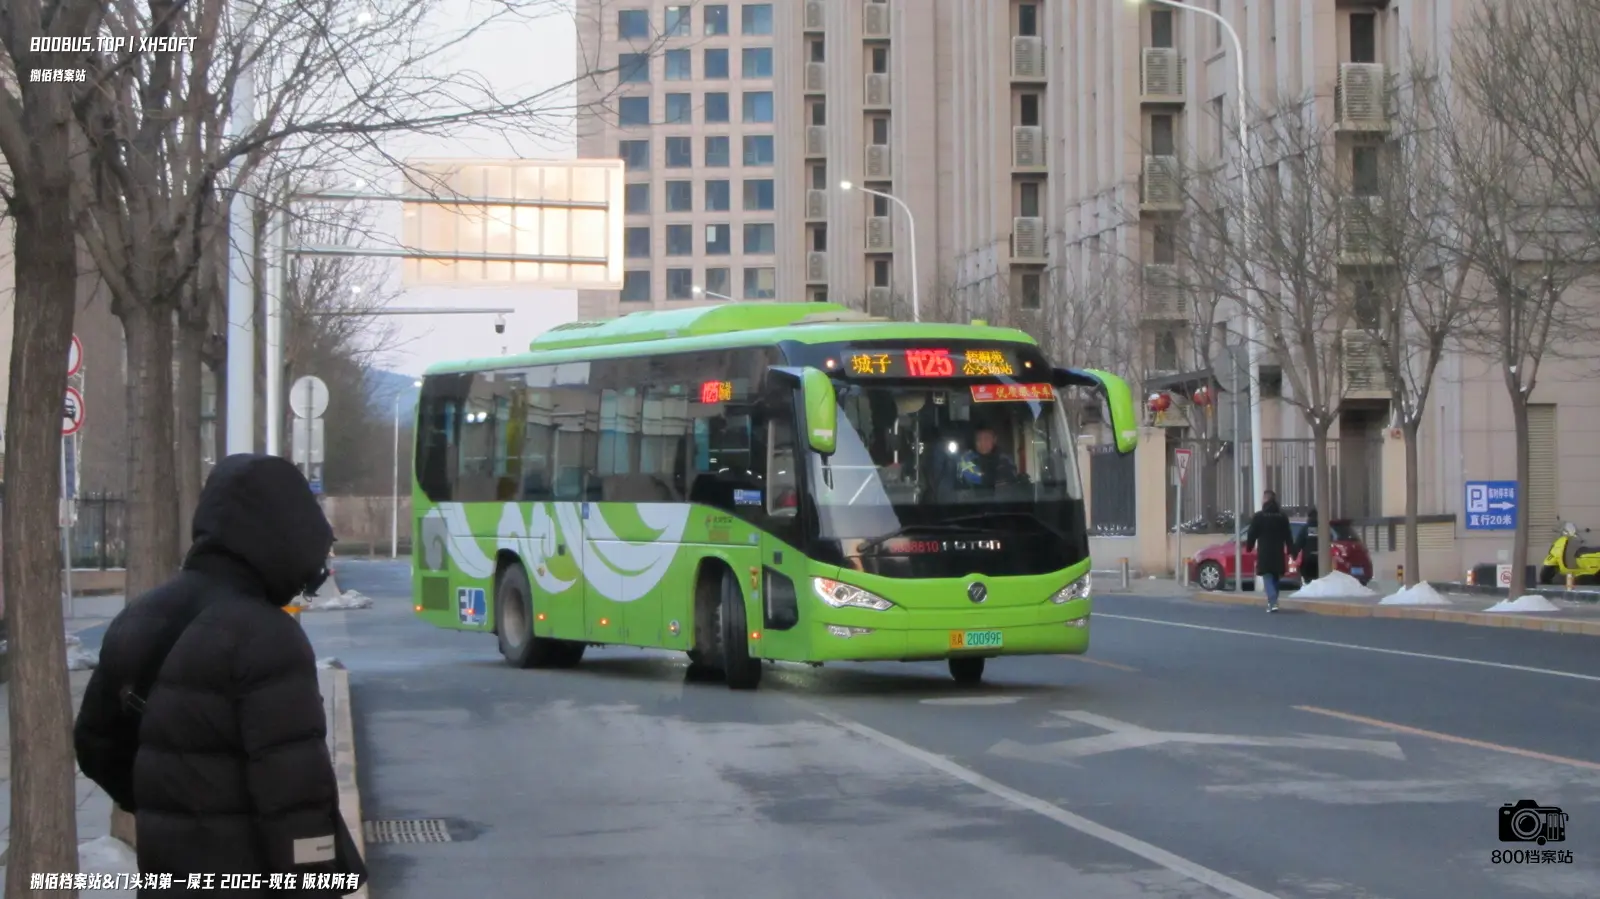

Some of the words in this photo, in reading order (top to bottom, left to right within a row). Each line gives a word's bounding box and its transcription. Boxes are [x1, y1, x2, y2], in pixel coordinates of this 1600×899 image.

[852, 354, 891, 374] 城子
[905, 348, 954, 376] M25
[963, 361, 1013, 375] 公交场站
[1470, 488, 1482, 509] P
[1470, 514, 1512, 526] 直行20米
